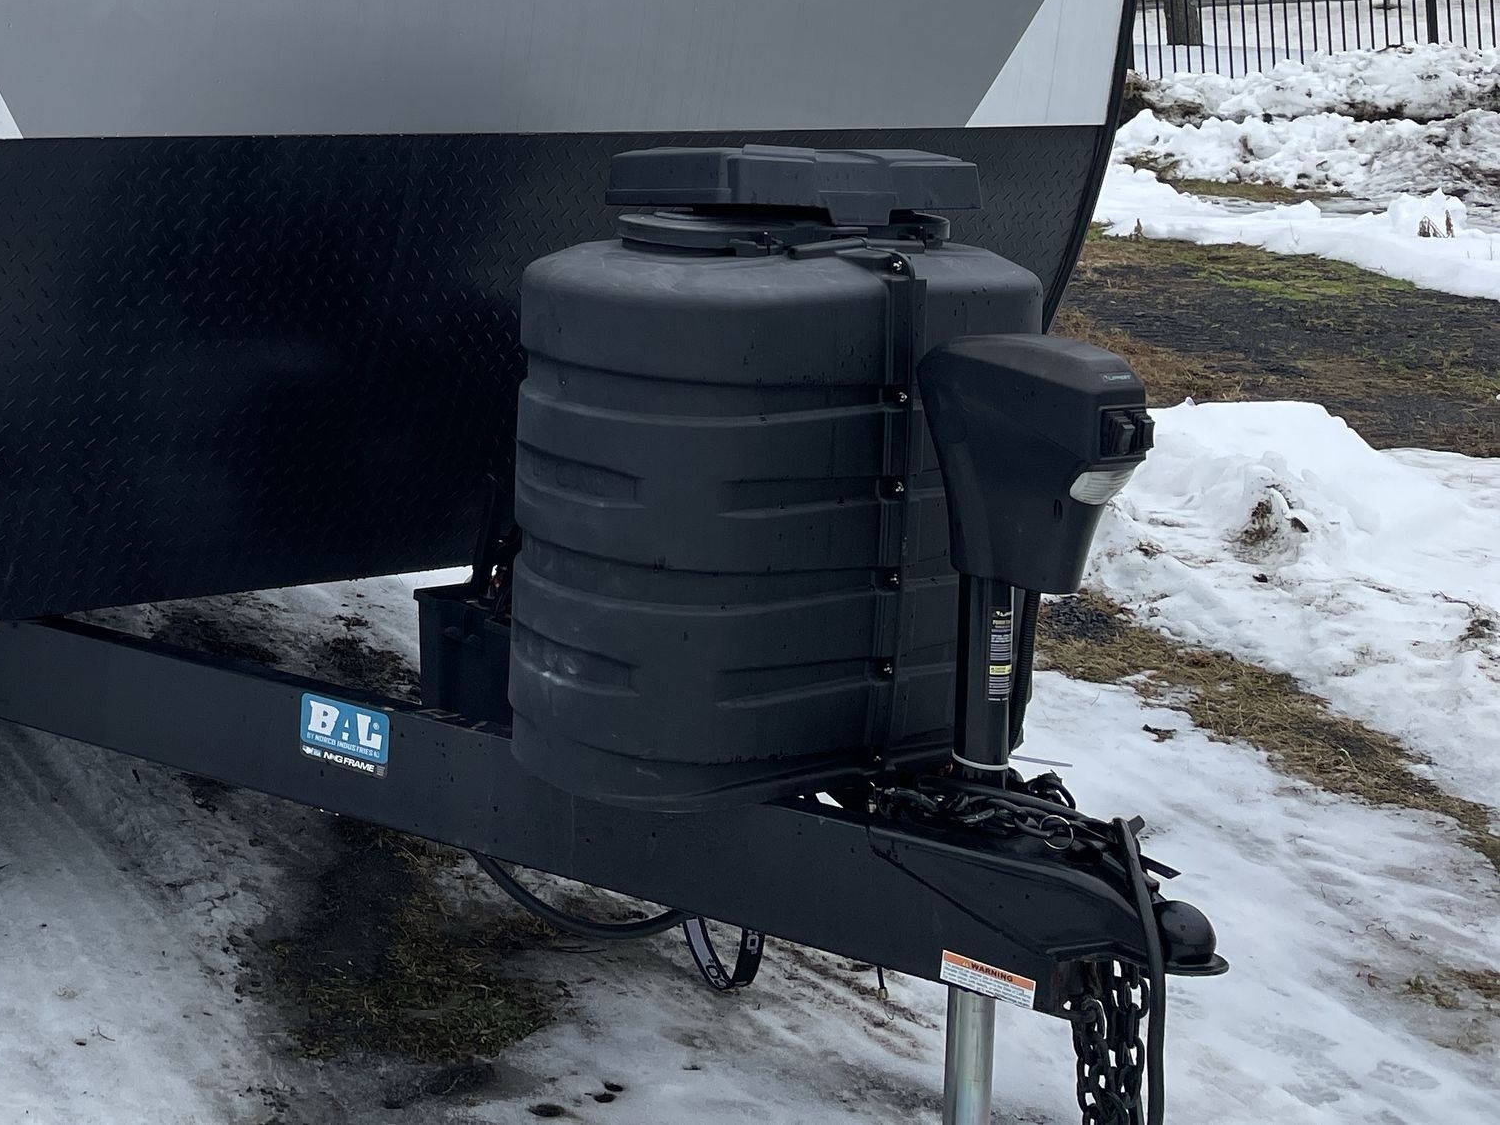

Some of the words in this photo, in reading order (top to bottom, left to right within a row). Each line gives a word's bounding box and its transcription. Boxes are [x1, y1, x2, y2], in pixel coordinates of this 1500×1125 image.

[307, 700, 382, 750] BAL
[343, 757, 375, 773] FRAME
[970, 962, 1014, 982] WARNING
